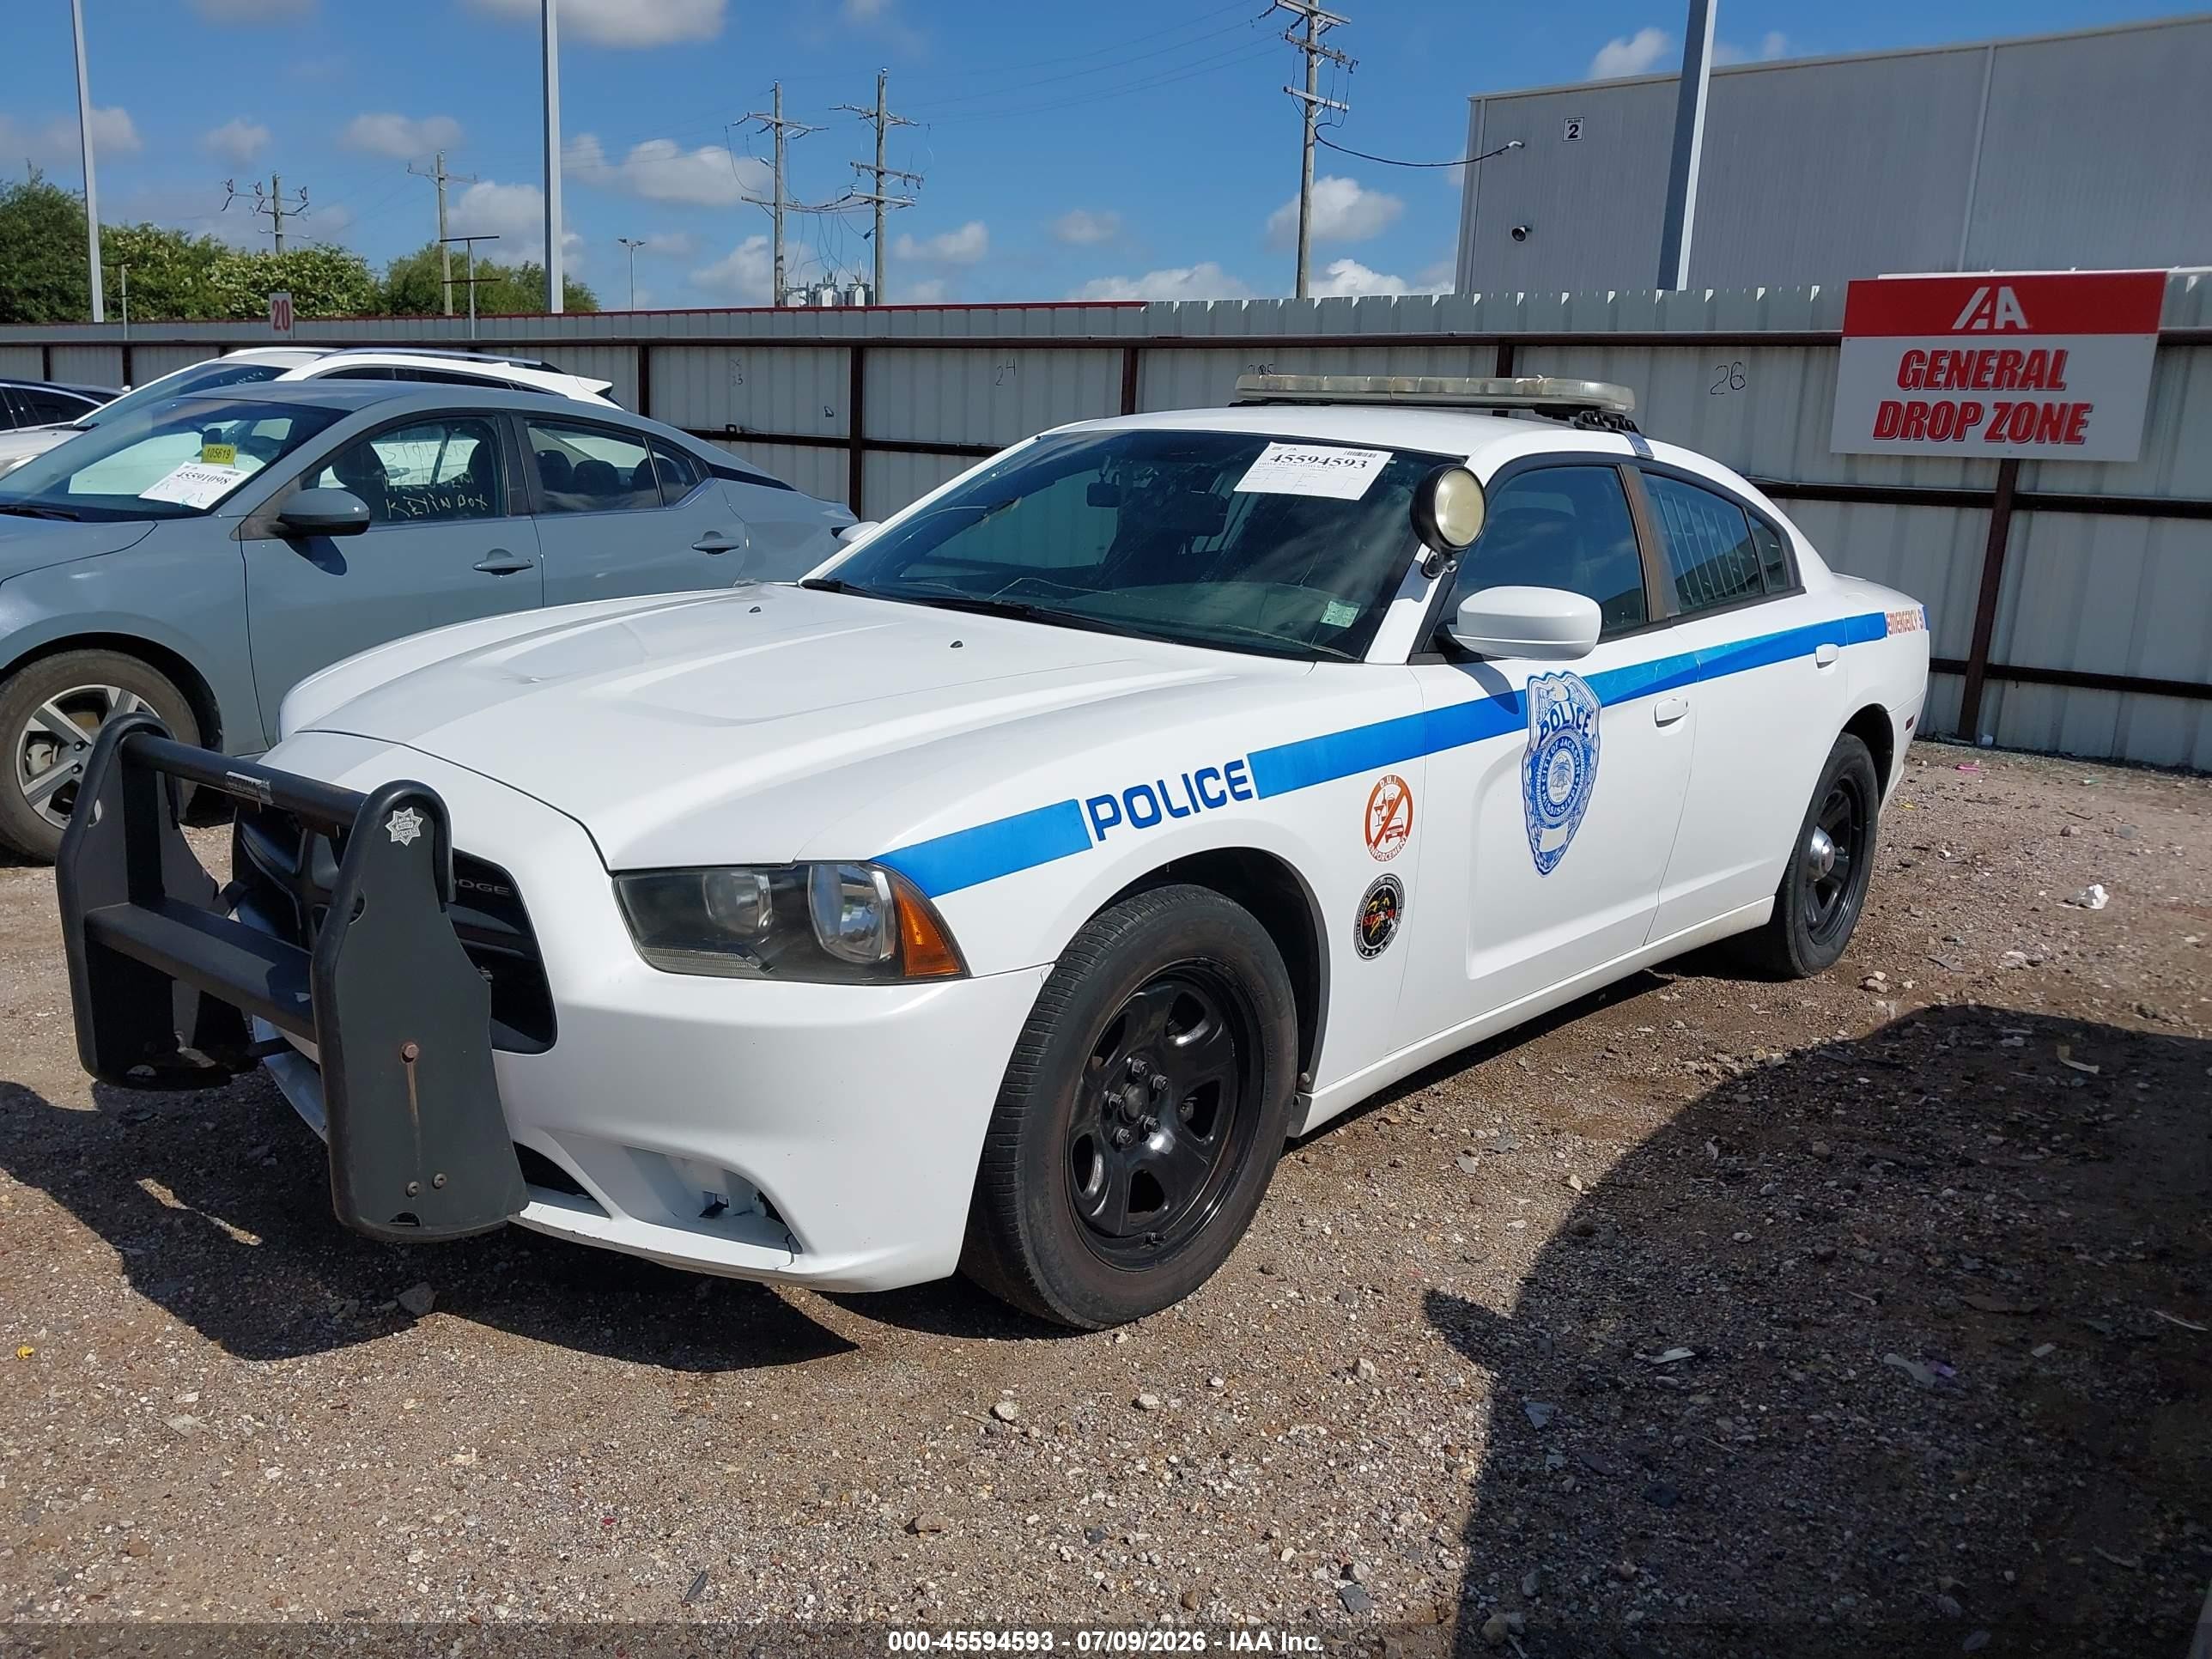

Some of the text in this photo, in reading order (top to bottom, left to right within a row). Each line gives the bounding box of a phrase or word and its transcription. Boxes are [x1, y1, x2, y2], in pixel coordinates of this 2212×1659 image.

[1568, 124, 1579, 138] 2
[271, 300, 290, 331] 20
[995, 357, 1016, 386] 24
[1896, 349, 2069, 392] GENERAL
[1872, 400, 2094, 446] DROP ZONE
[206, 447, 231, 459] 105619
[1269, 453, 1369, 470] 45594593
[1537, 702, 1592, 749] POLICE
[1541, 738, 1581, 783] CITY OF JACKSON
[1085, 759, 1254, 842] POLICE
[1541, 784, 1578, 816] MISSISSIPPI
[1368, 835, 1407, 861] ENFORCEMENT
[454, 878, 509, 896] DGE
